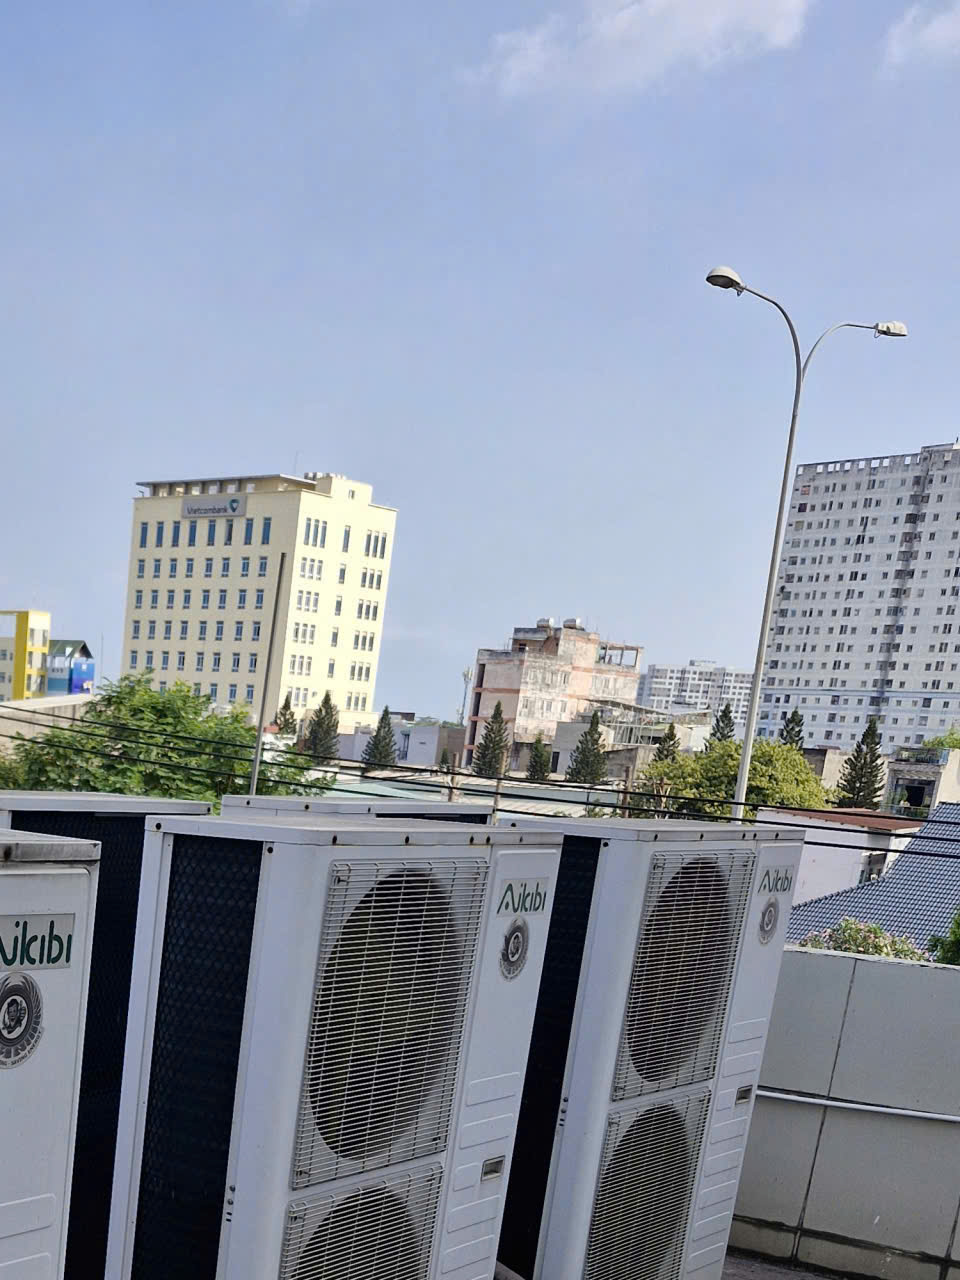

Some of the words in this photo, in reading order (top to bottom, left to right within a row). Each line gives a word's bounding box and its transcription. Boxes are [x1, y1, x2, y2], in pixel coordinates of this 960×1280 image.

[187, 504, 228, 515] Vietcombank
[758, 870, 793, 893] Aikibi
[497, 883, 547, 914] Aikibi
